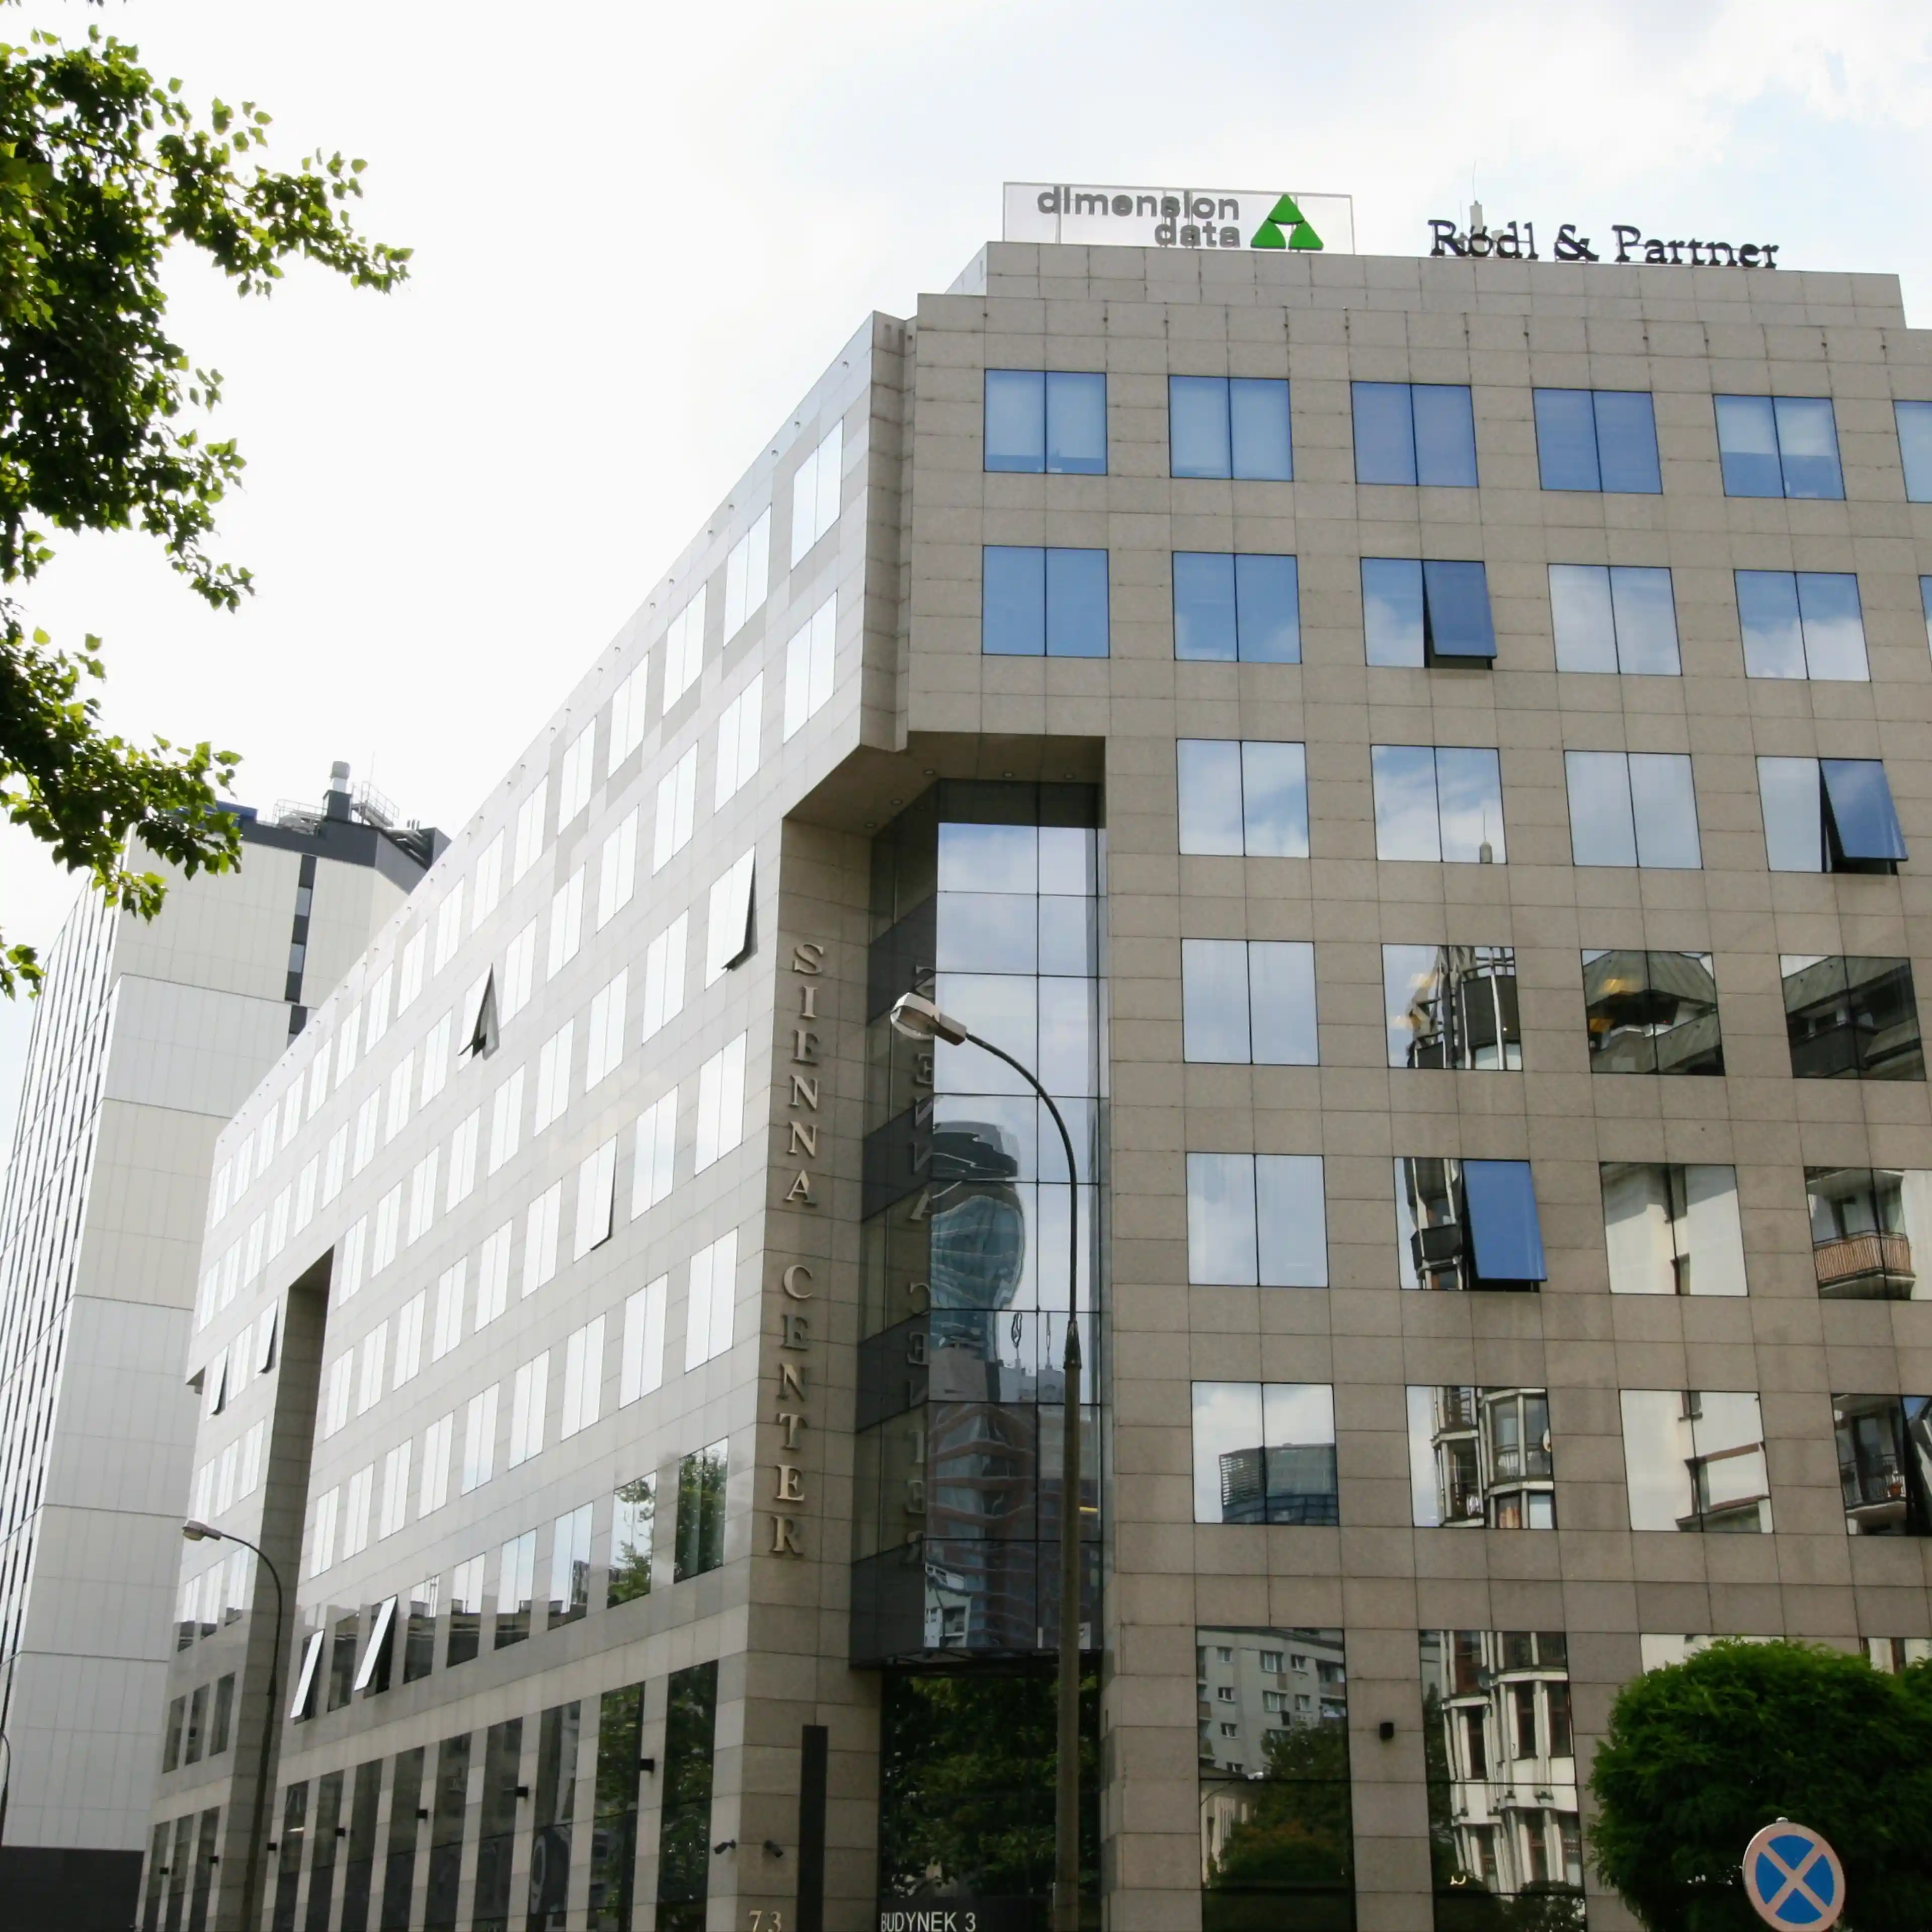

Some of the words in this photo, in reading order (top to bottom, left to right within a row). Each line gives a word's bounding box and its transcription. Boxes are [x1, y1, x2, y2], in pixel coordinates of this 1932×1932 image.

[1037, 185, 1240, 220] dimension
[1154, 217, 1241, 249] data
[1555, 223, 1599, 263] &
[1612, 224, 1780, 269] Partner
[783, 943, 824, 1205] SIENNA
[768, 1264, 813, 1556] CENTER
[748, 1910, 782, 1932] 73
[881, 1911, 957, 1932] BUDYNEK
[964, 1912, 976, 1932] 3
